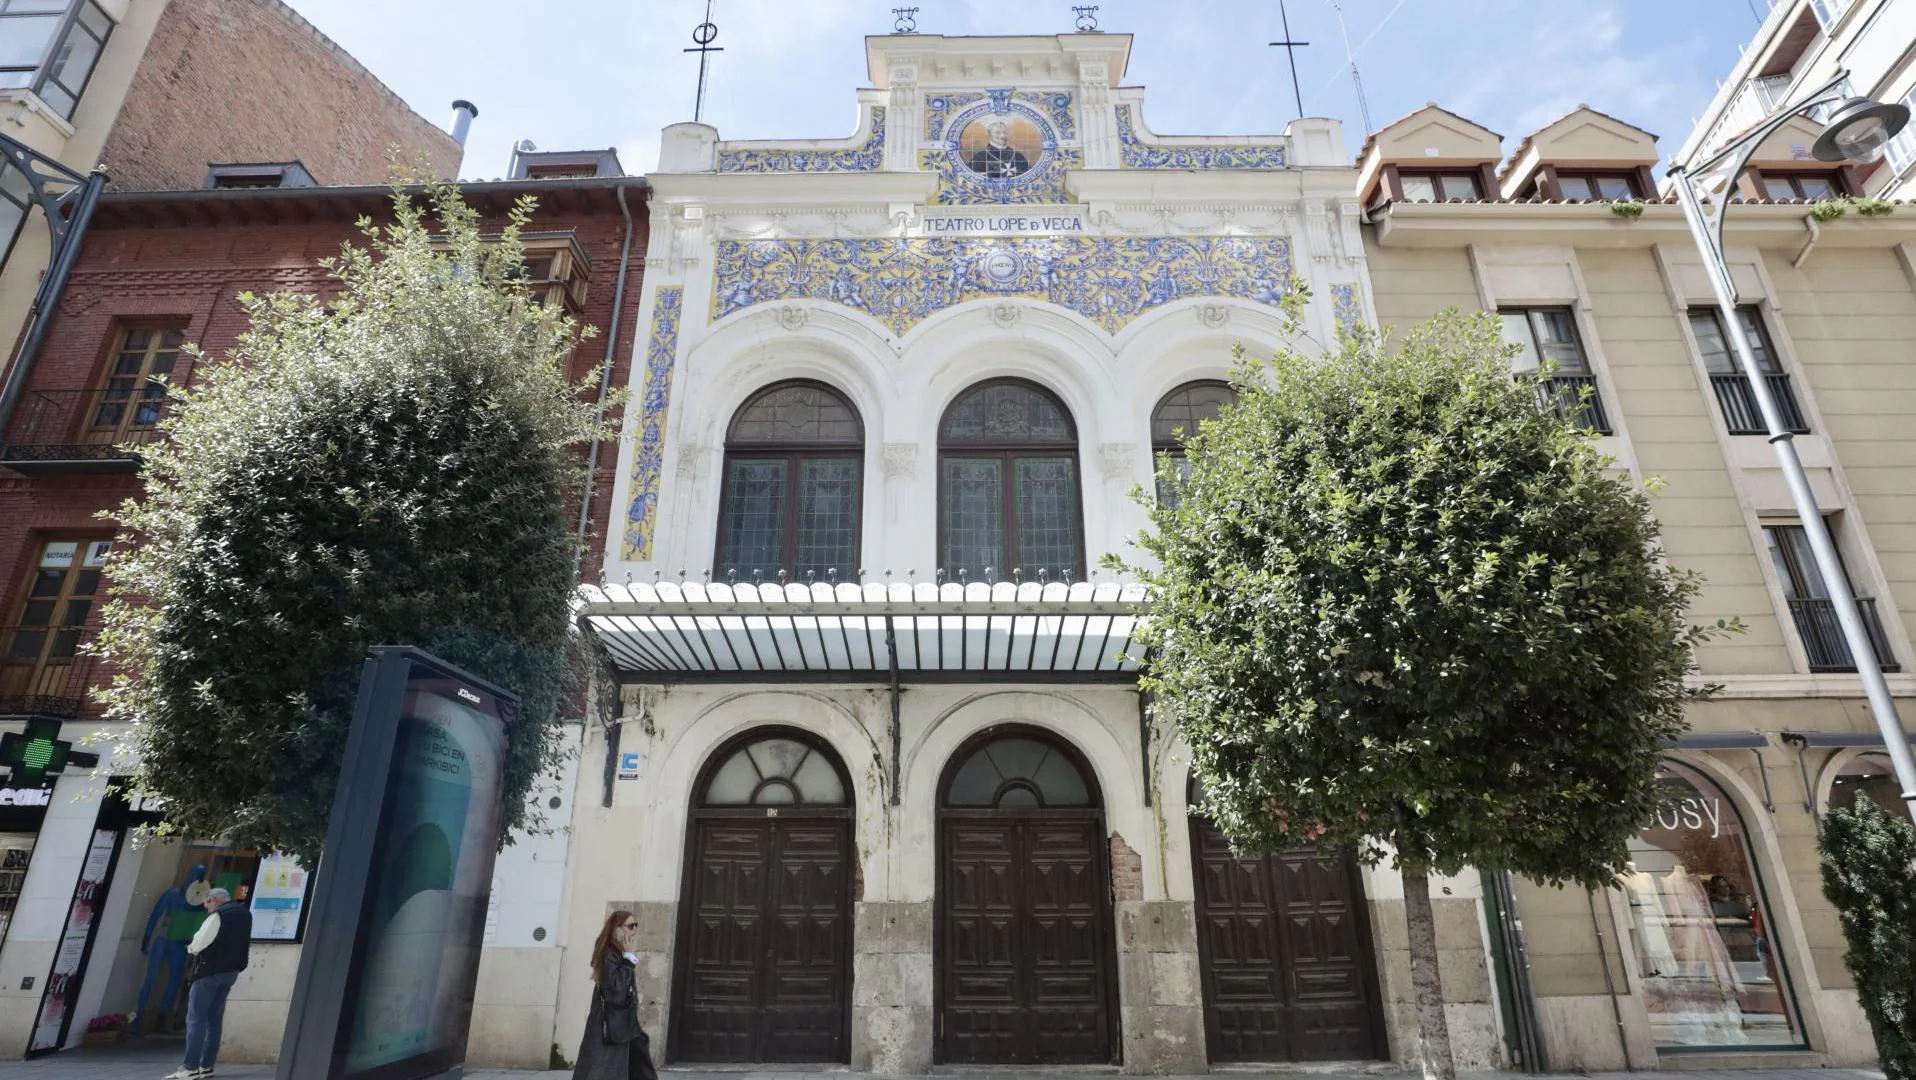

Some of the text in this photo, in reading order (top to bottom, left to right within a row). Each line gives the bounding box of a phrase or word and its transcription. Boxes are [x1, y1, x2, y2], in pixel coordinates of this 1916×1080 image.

[924, 217, 984, 232] TEATRO
[989, 217, 1027, 232] LOPE
[1642, 798, 1720, 839] osy
